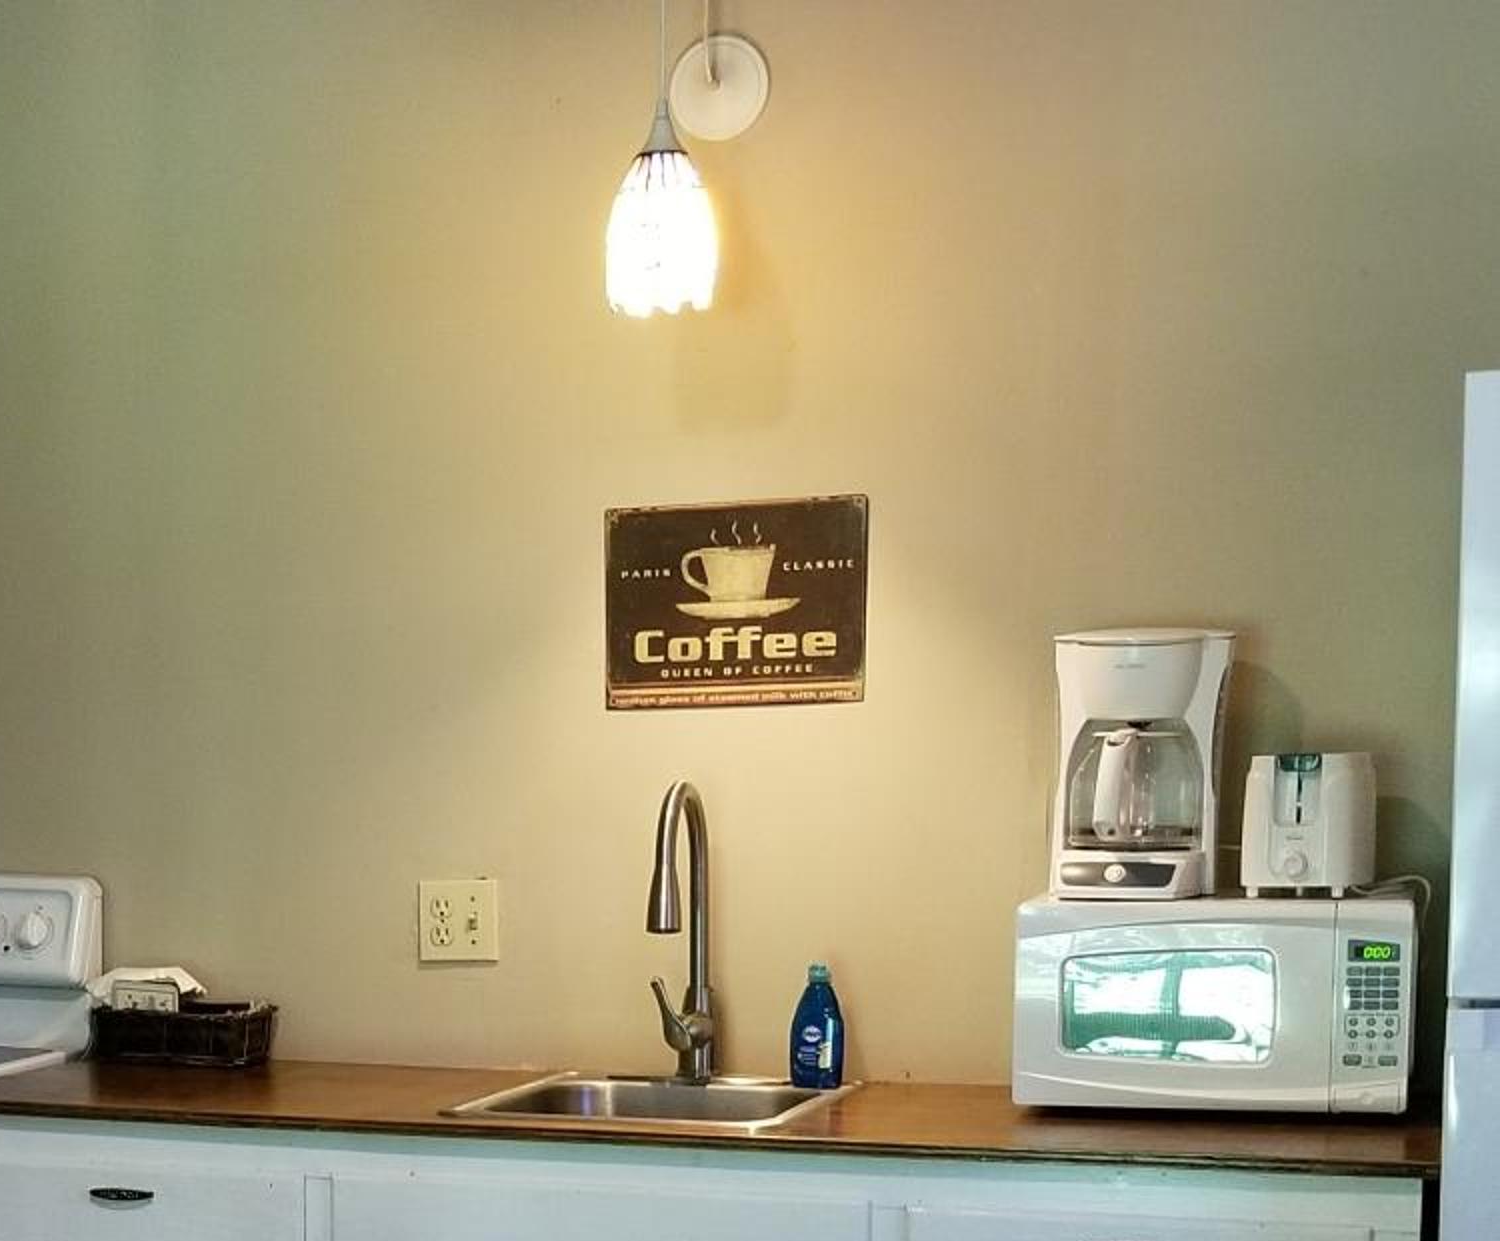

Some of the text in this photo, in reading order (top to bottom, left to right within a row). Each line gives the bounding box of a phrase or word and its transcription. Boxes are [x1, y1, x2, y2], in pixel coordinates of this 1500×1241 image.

[782, 559, 855, 571] CLASSIC
[620, 568, 671, 579] PARIS
[634, 625, 837, 663] Coffee
[661, 664, 814, 678] QUEEN OF COFFEE
